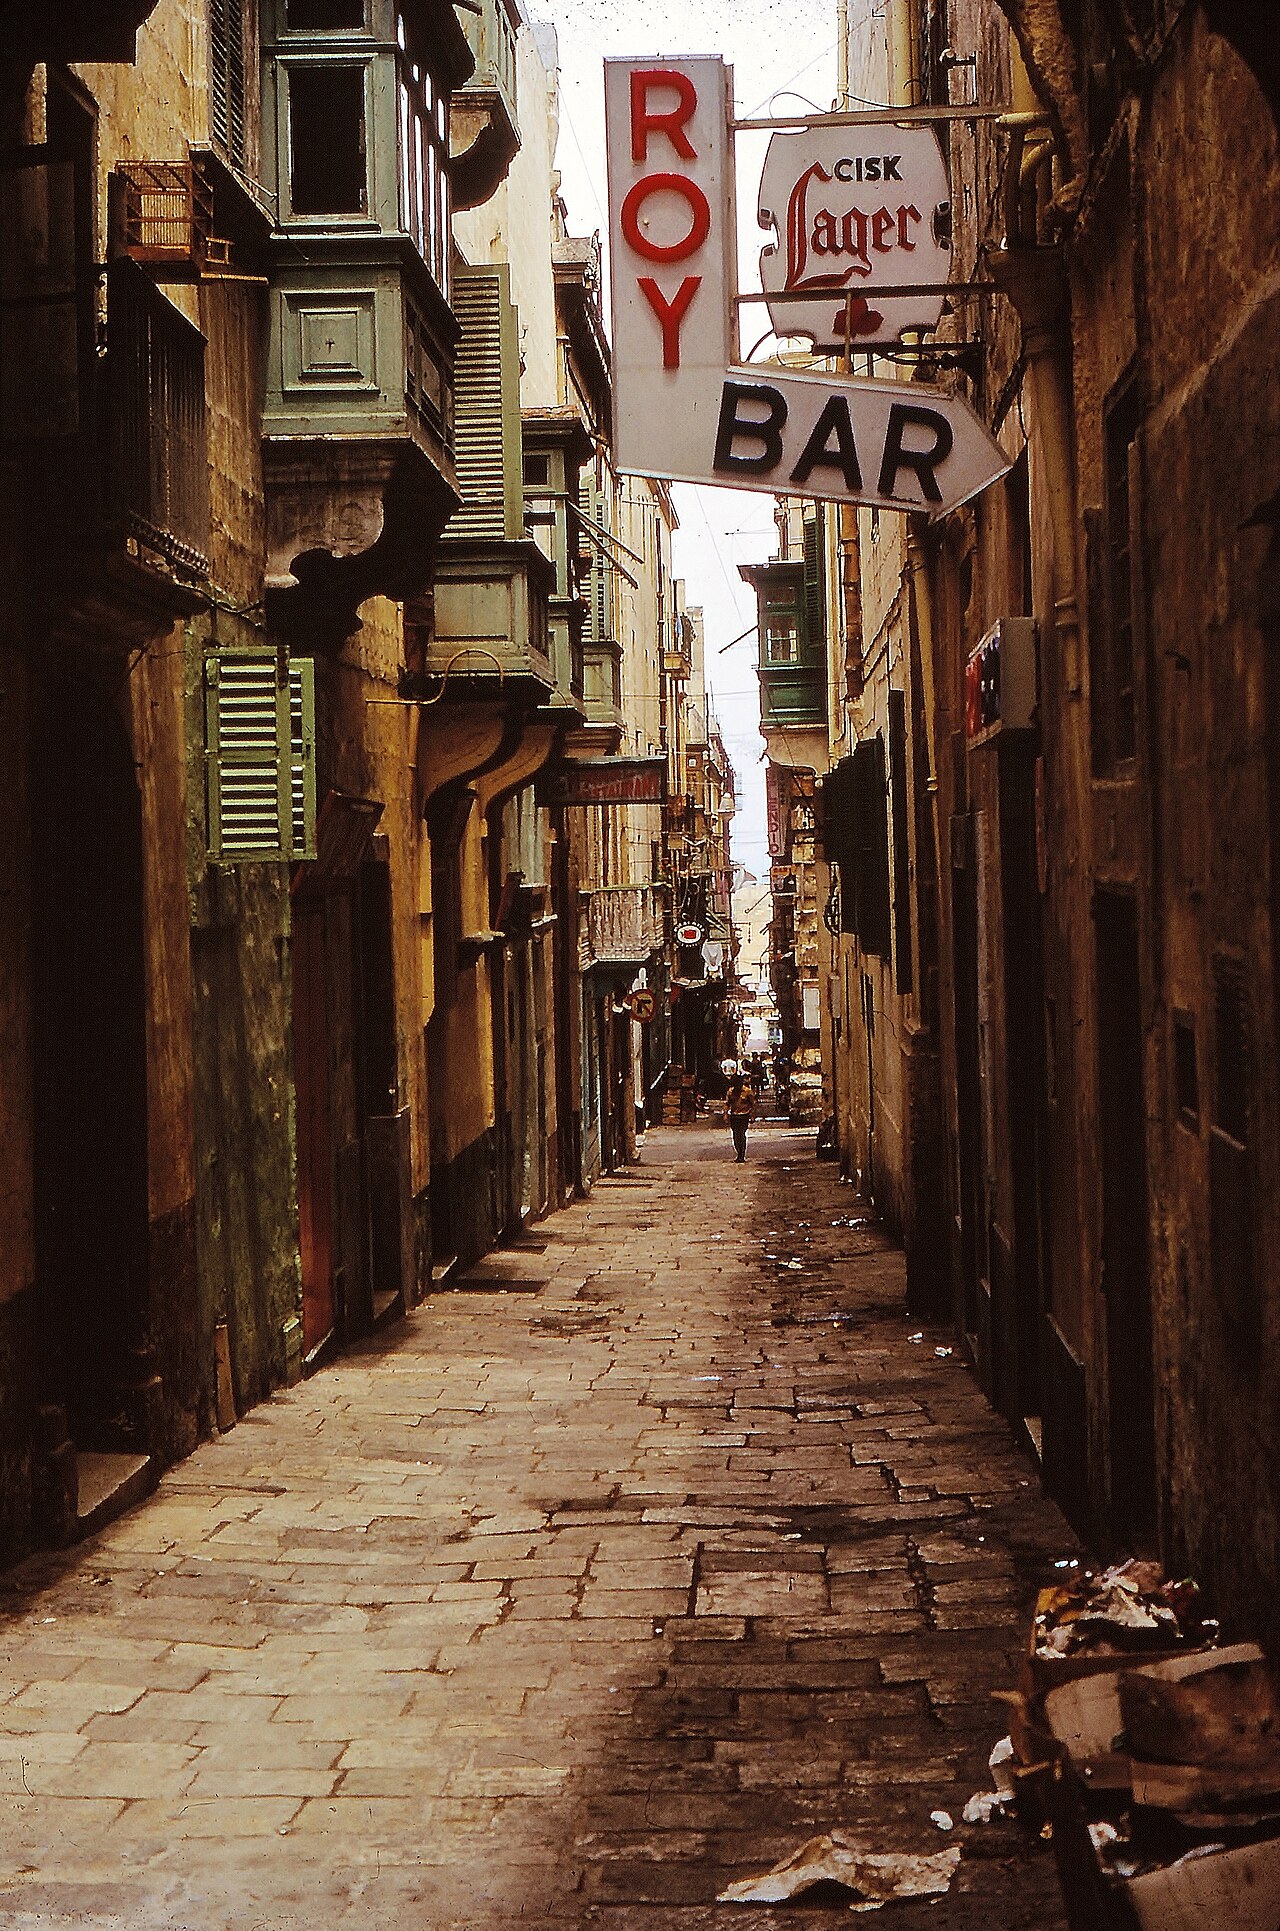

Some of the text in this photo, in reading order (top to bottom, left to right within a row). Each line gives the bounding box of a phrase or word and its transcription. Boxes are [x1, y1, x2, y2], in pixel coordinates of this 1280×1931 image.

[621, 69, 711, 369] ROY
[785, 160, 922, 291] Lager
[833, 155, 903, 183] CISK
[713, 381, 954, 504] BAR
